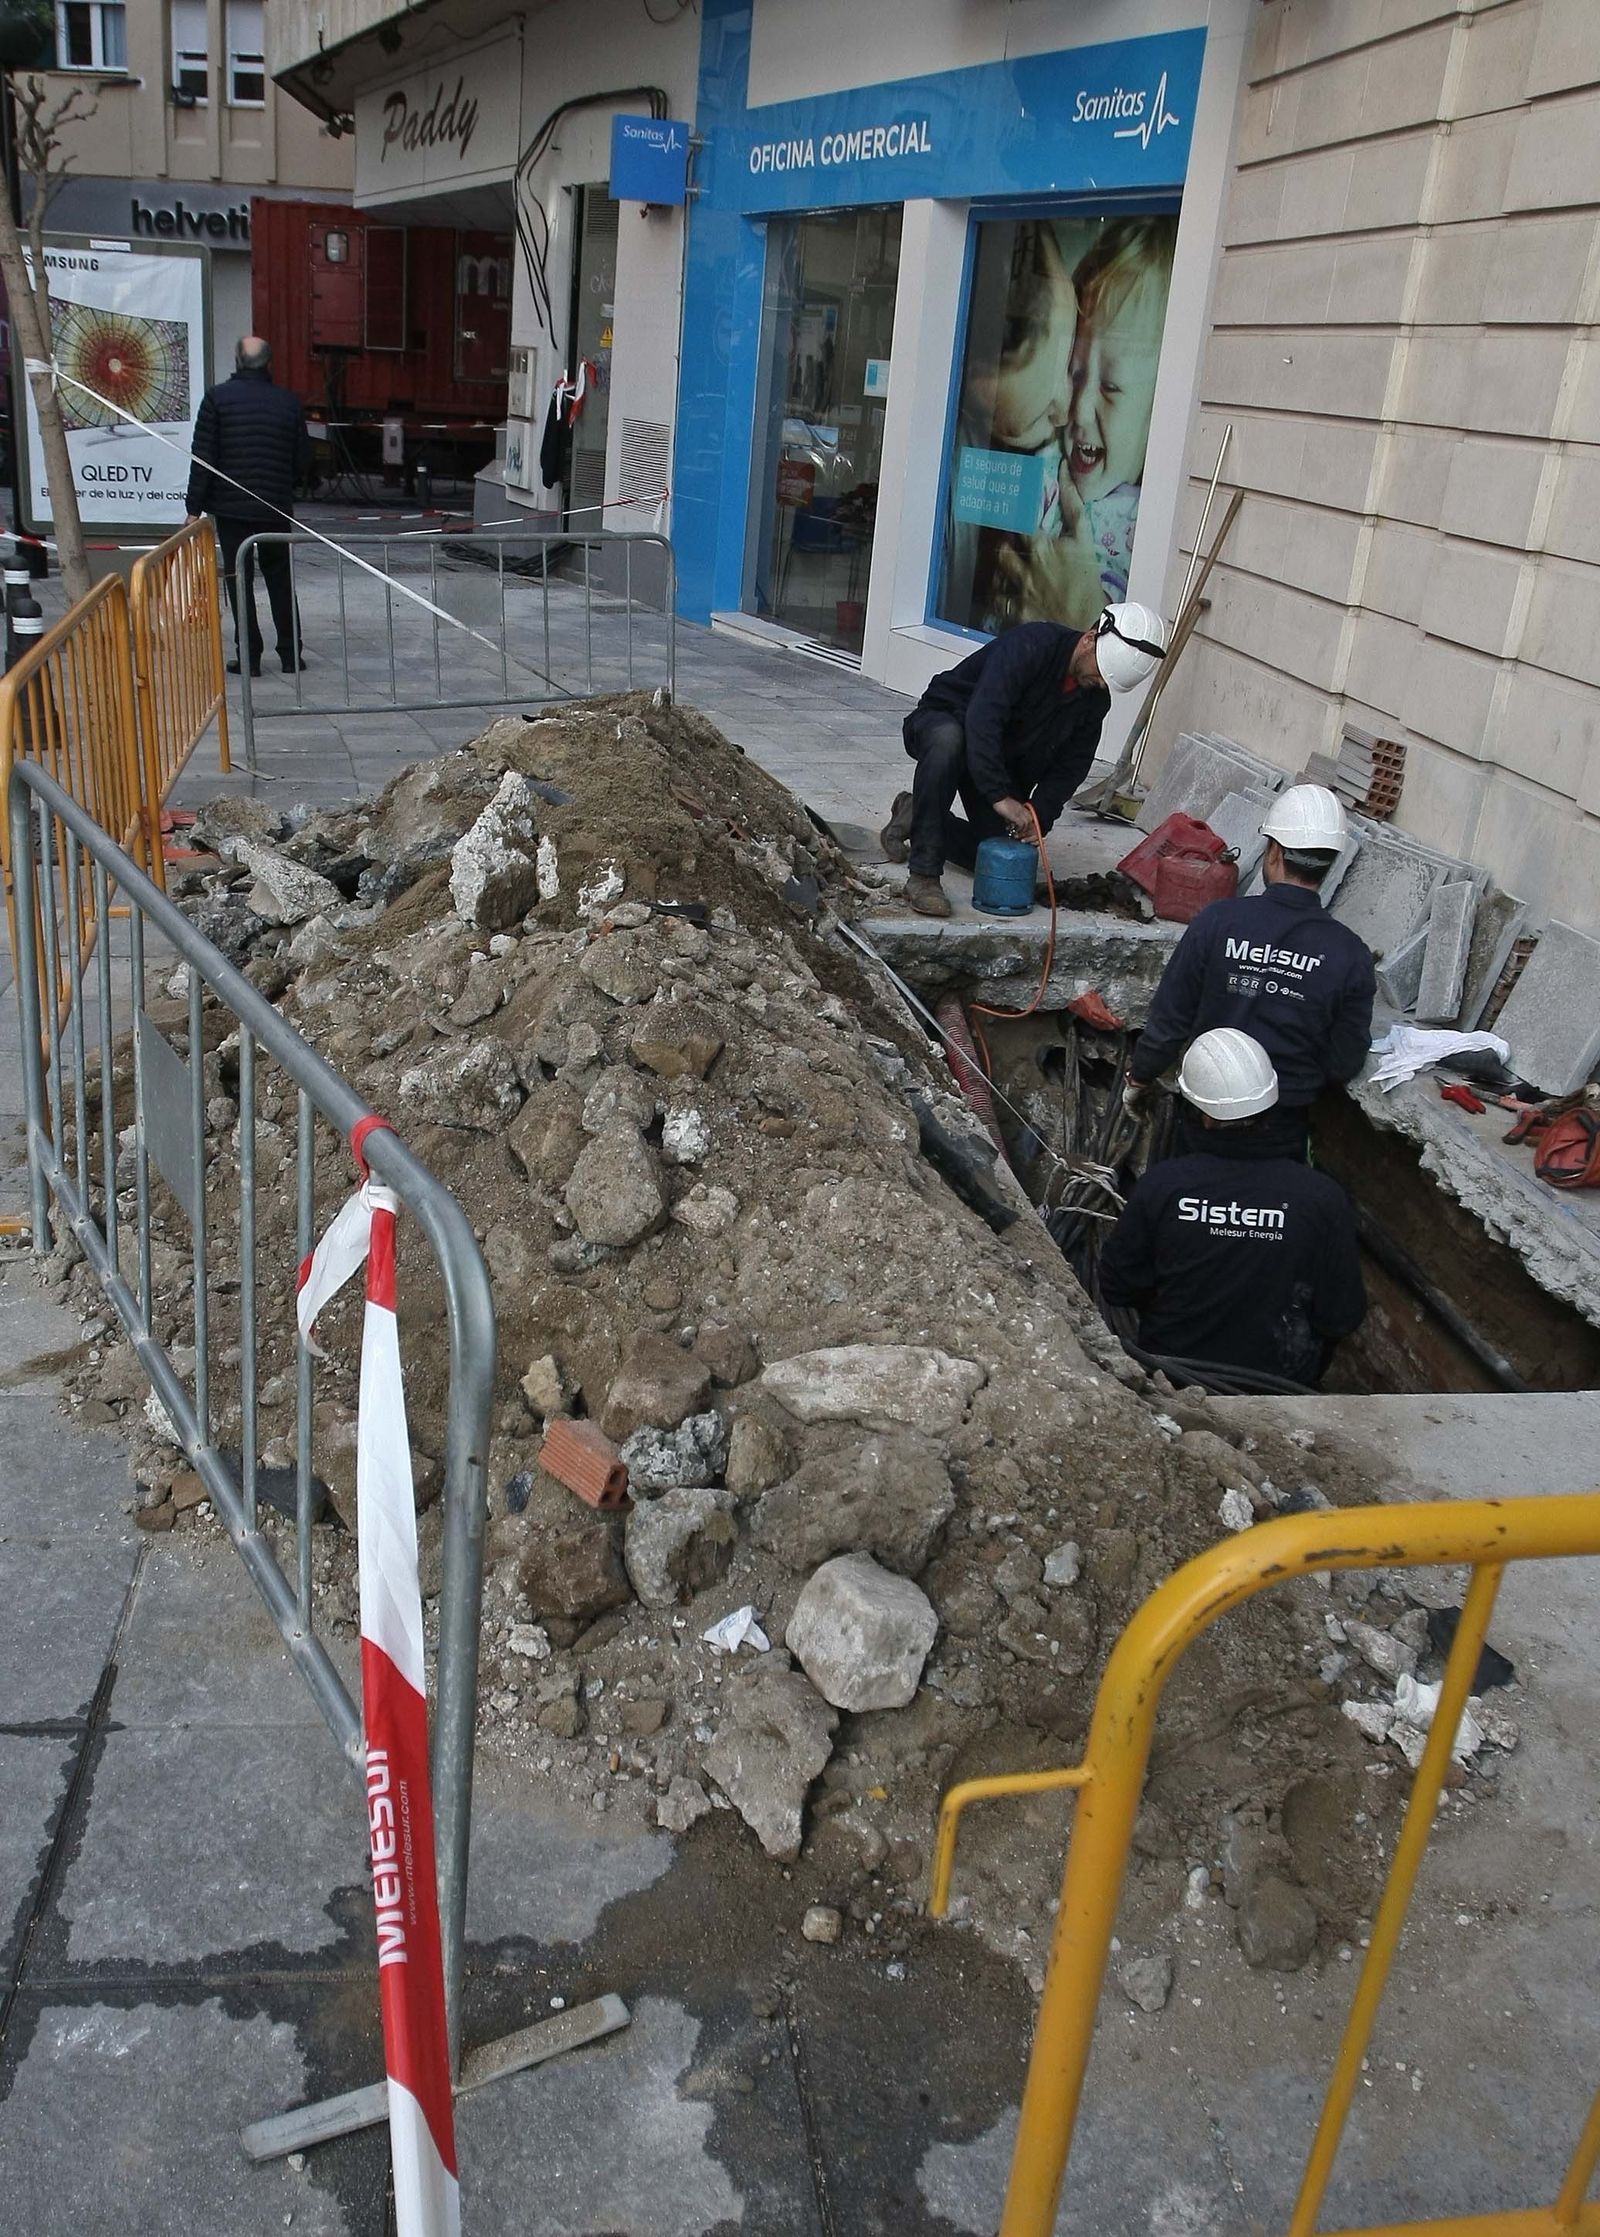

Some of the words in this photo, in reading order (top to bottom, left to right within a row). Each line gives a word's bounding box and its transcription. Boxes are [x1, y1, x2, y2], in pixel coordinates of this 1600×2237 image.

[1072, 87, 1146, 122] Sanitas
[381, 75, 479, 163] Paddy
[624, 124, 664, 141] Sanitas
[750, 138, 815, 174] OFICINA
[820, 120, 931, 165] COMERCIAL
[131, 199, 250, 240] helveti
[23, 253, 100, 271] SMSUNG
[81, 465, 129, 482] QLED
[131, 466, 153, 483] TV
[976, 457, 1007, 474] seguro
[1010, 462, 1023, 477] de
[89, 488, 104, 498] de
[106, 488, 117, 499] la
[118, 489, 134, 499] luz
[137, 491, 144, 502] y
[146, 490, 164, 500] del
[165, 491, 189, 501] colo
[961, 474, 987, 490] salud
[989, 481, 1006, 495] que
[1009, 484, 1020, 497] se
[1178, 1197, 1285, 1228] Sistem
[1210, 1227, 1246, 1238] Melesur
[1249, 1229, 1283, 1241] Energía
[400, 1780, 417, 1926] www.melesur.com
